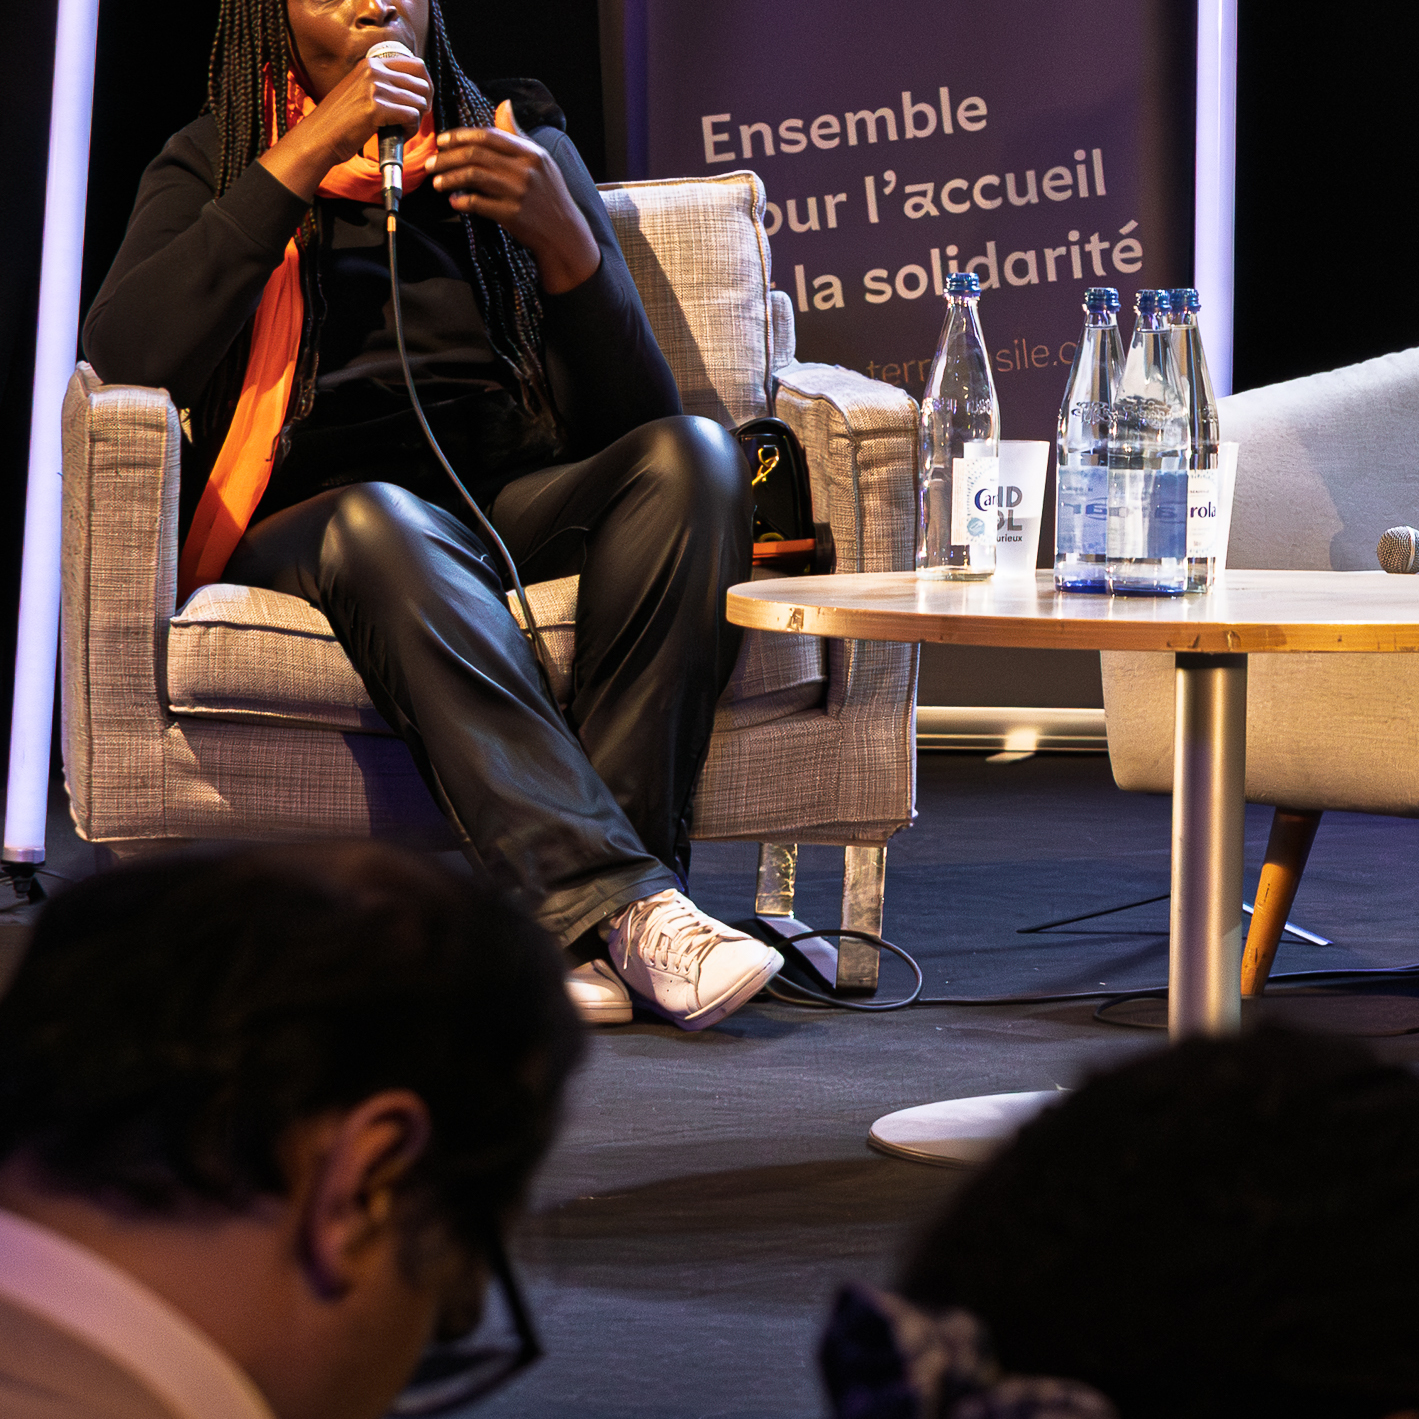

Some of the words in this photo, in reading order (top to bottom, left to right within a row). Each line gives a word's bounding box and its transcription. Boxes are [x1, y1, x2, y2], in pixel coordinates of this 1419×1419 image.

[702, 87, 988, 164] Ensemble
[764, 190, 847, 236] our
[865, 147, 1107, 224] l'accueil
[795, 264, 845, 313] la
[1190, 501, 1216, 518] rola
[997, 534, 1022, 542] urieux
